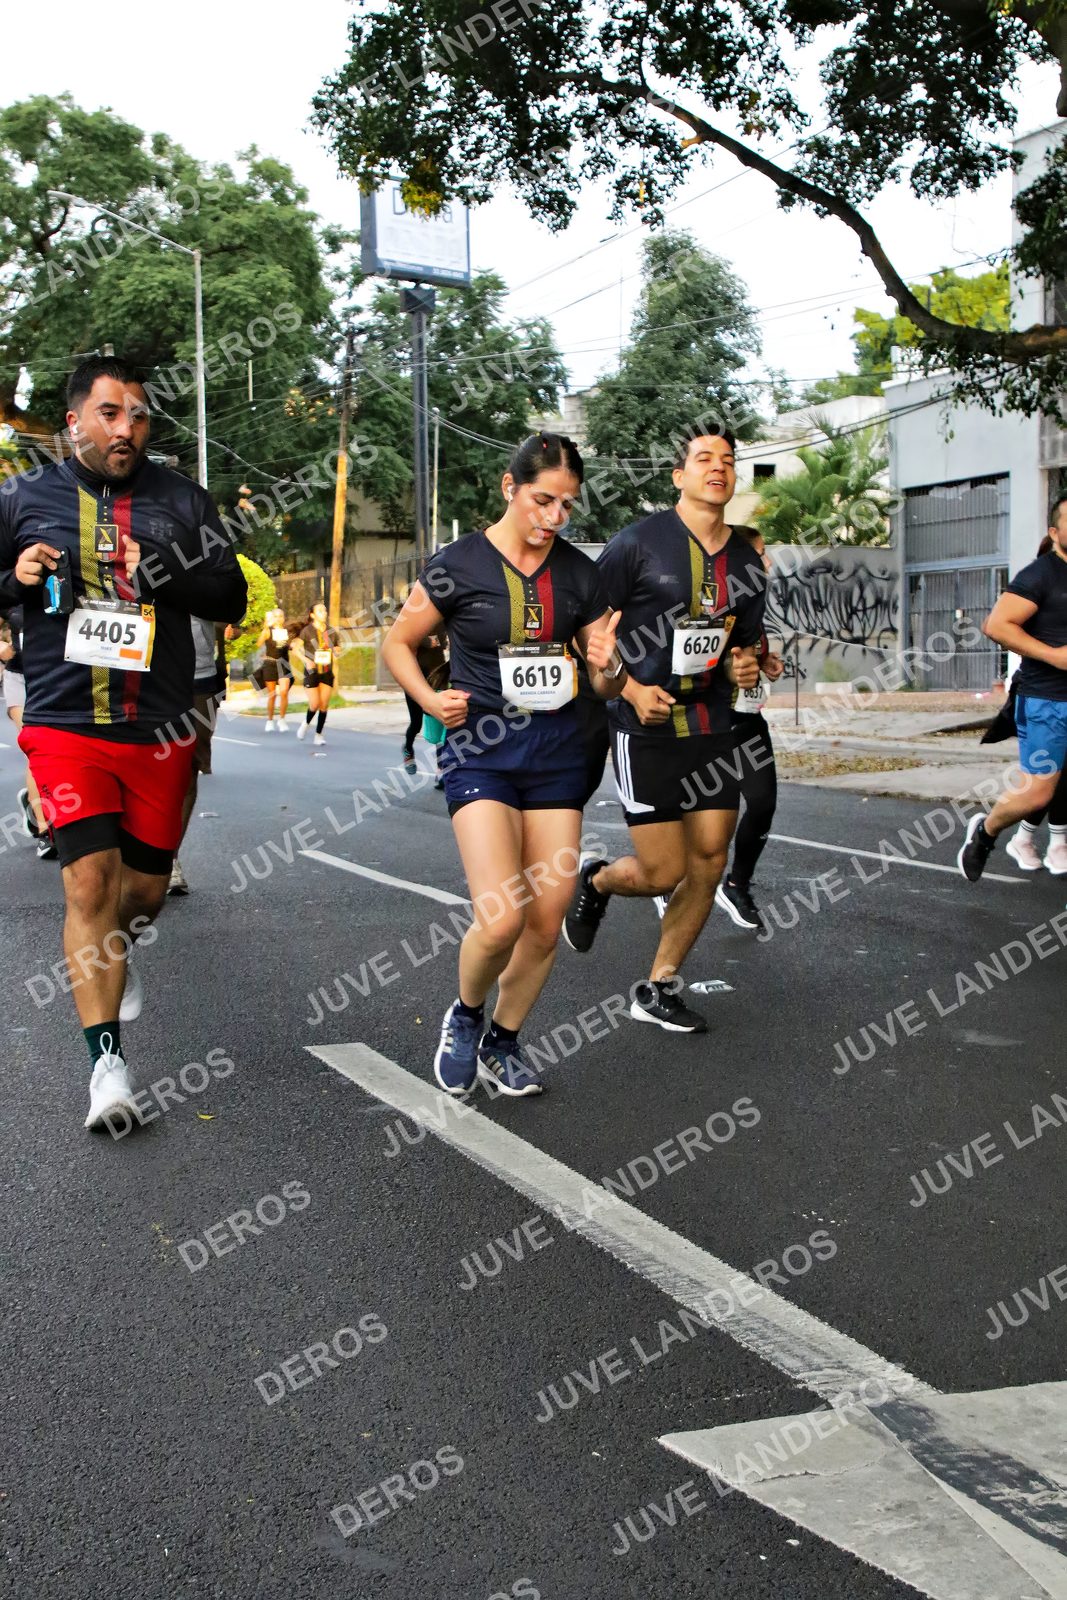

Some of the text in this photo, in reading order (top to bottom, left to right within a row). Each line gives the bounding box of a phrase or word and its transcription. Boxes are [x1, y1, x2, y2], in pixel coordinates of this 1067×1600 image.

[79, 618, 136, 645] 4405
[683, 635, 720, 655] 6620
[512, 665, 562, 688] 6619
